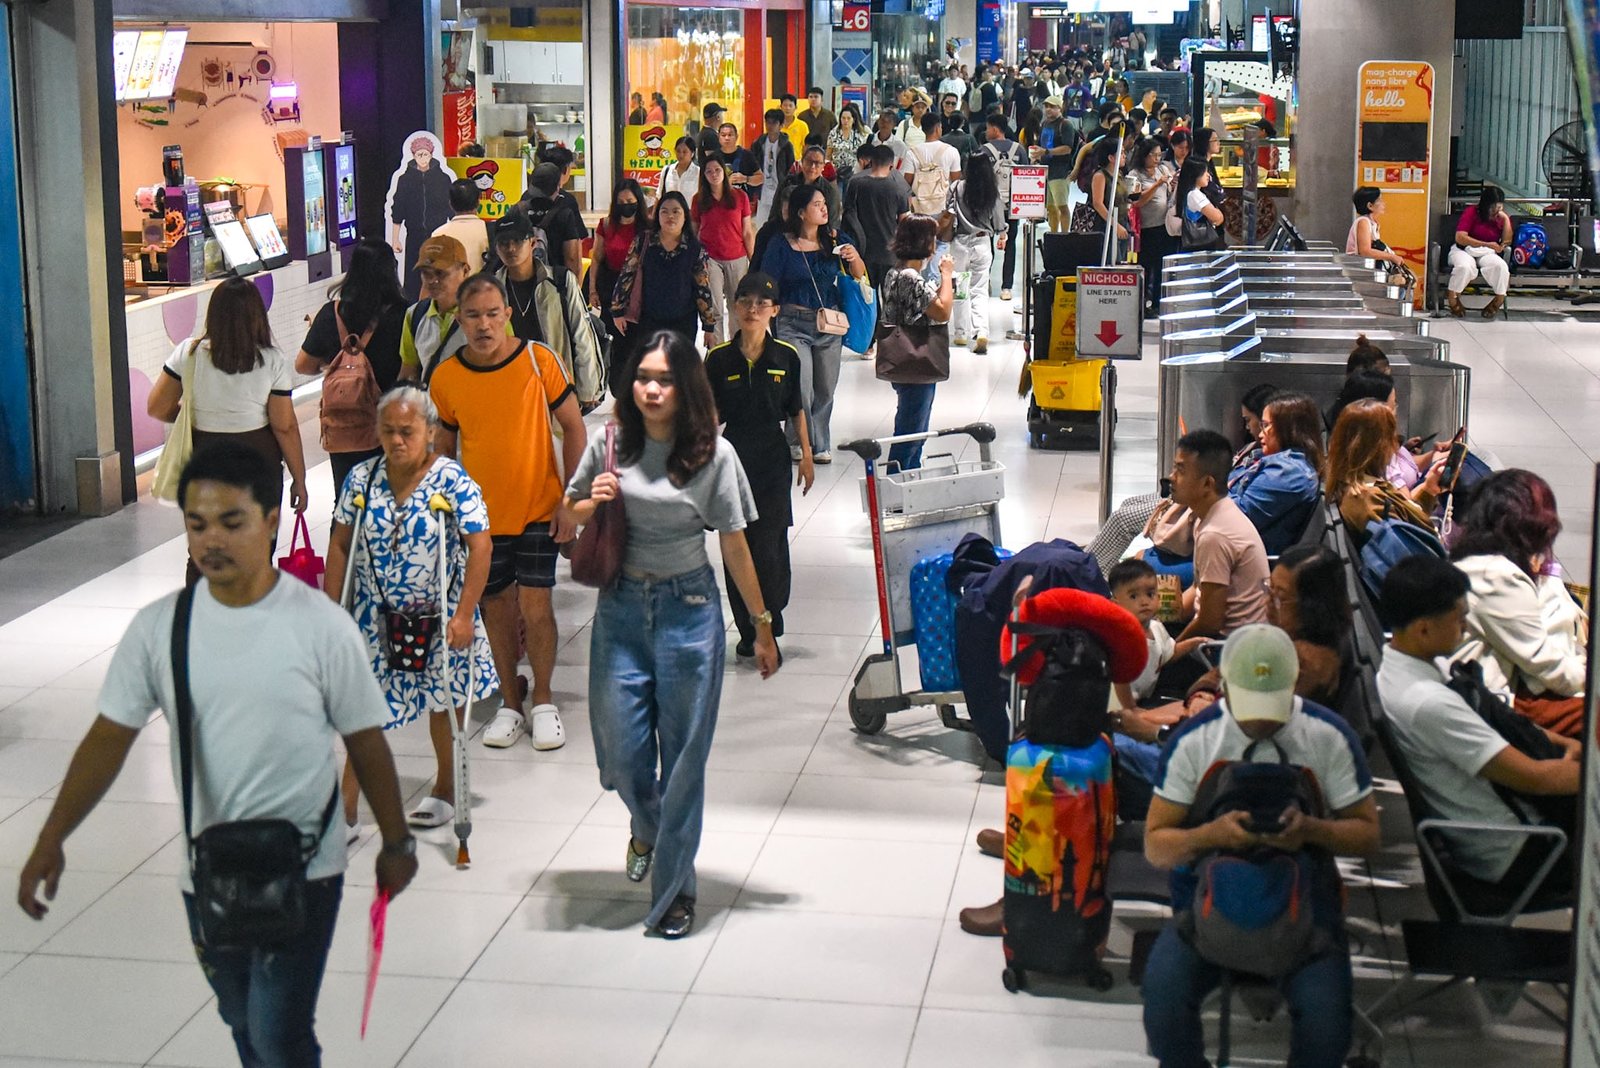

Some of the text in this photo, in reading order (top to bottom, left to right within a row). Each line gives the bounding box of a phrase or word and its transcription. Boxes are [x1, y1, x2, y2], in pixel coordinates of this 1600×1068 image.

[854, 9, 869, 29] 6
[993, 13, 1000, 22] 3
[1366, 68, 1418, 77] mag-charge
[1365, 77, 1408, 87] nang libre
[1365, 90, 1406, 107] hello
[629, 159, 654, 169] HEN
[1013, 194, 1043, 202] ALABANG
[1084, 273, 1134, 284] NICHOLS
[1103, 289, 1132, 297] STARTS
